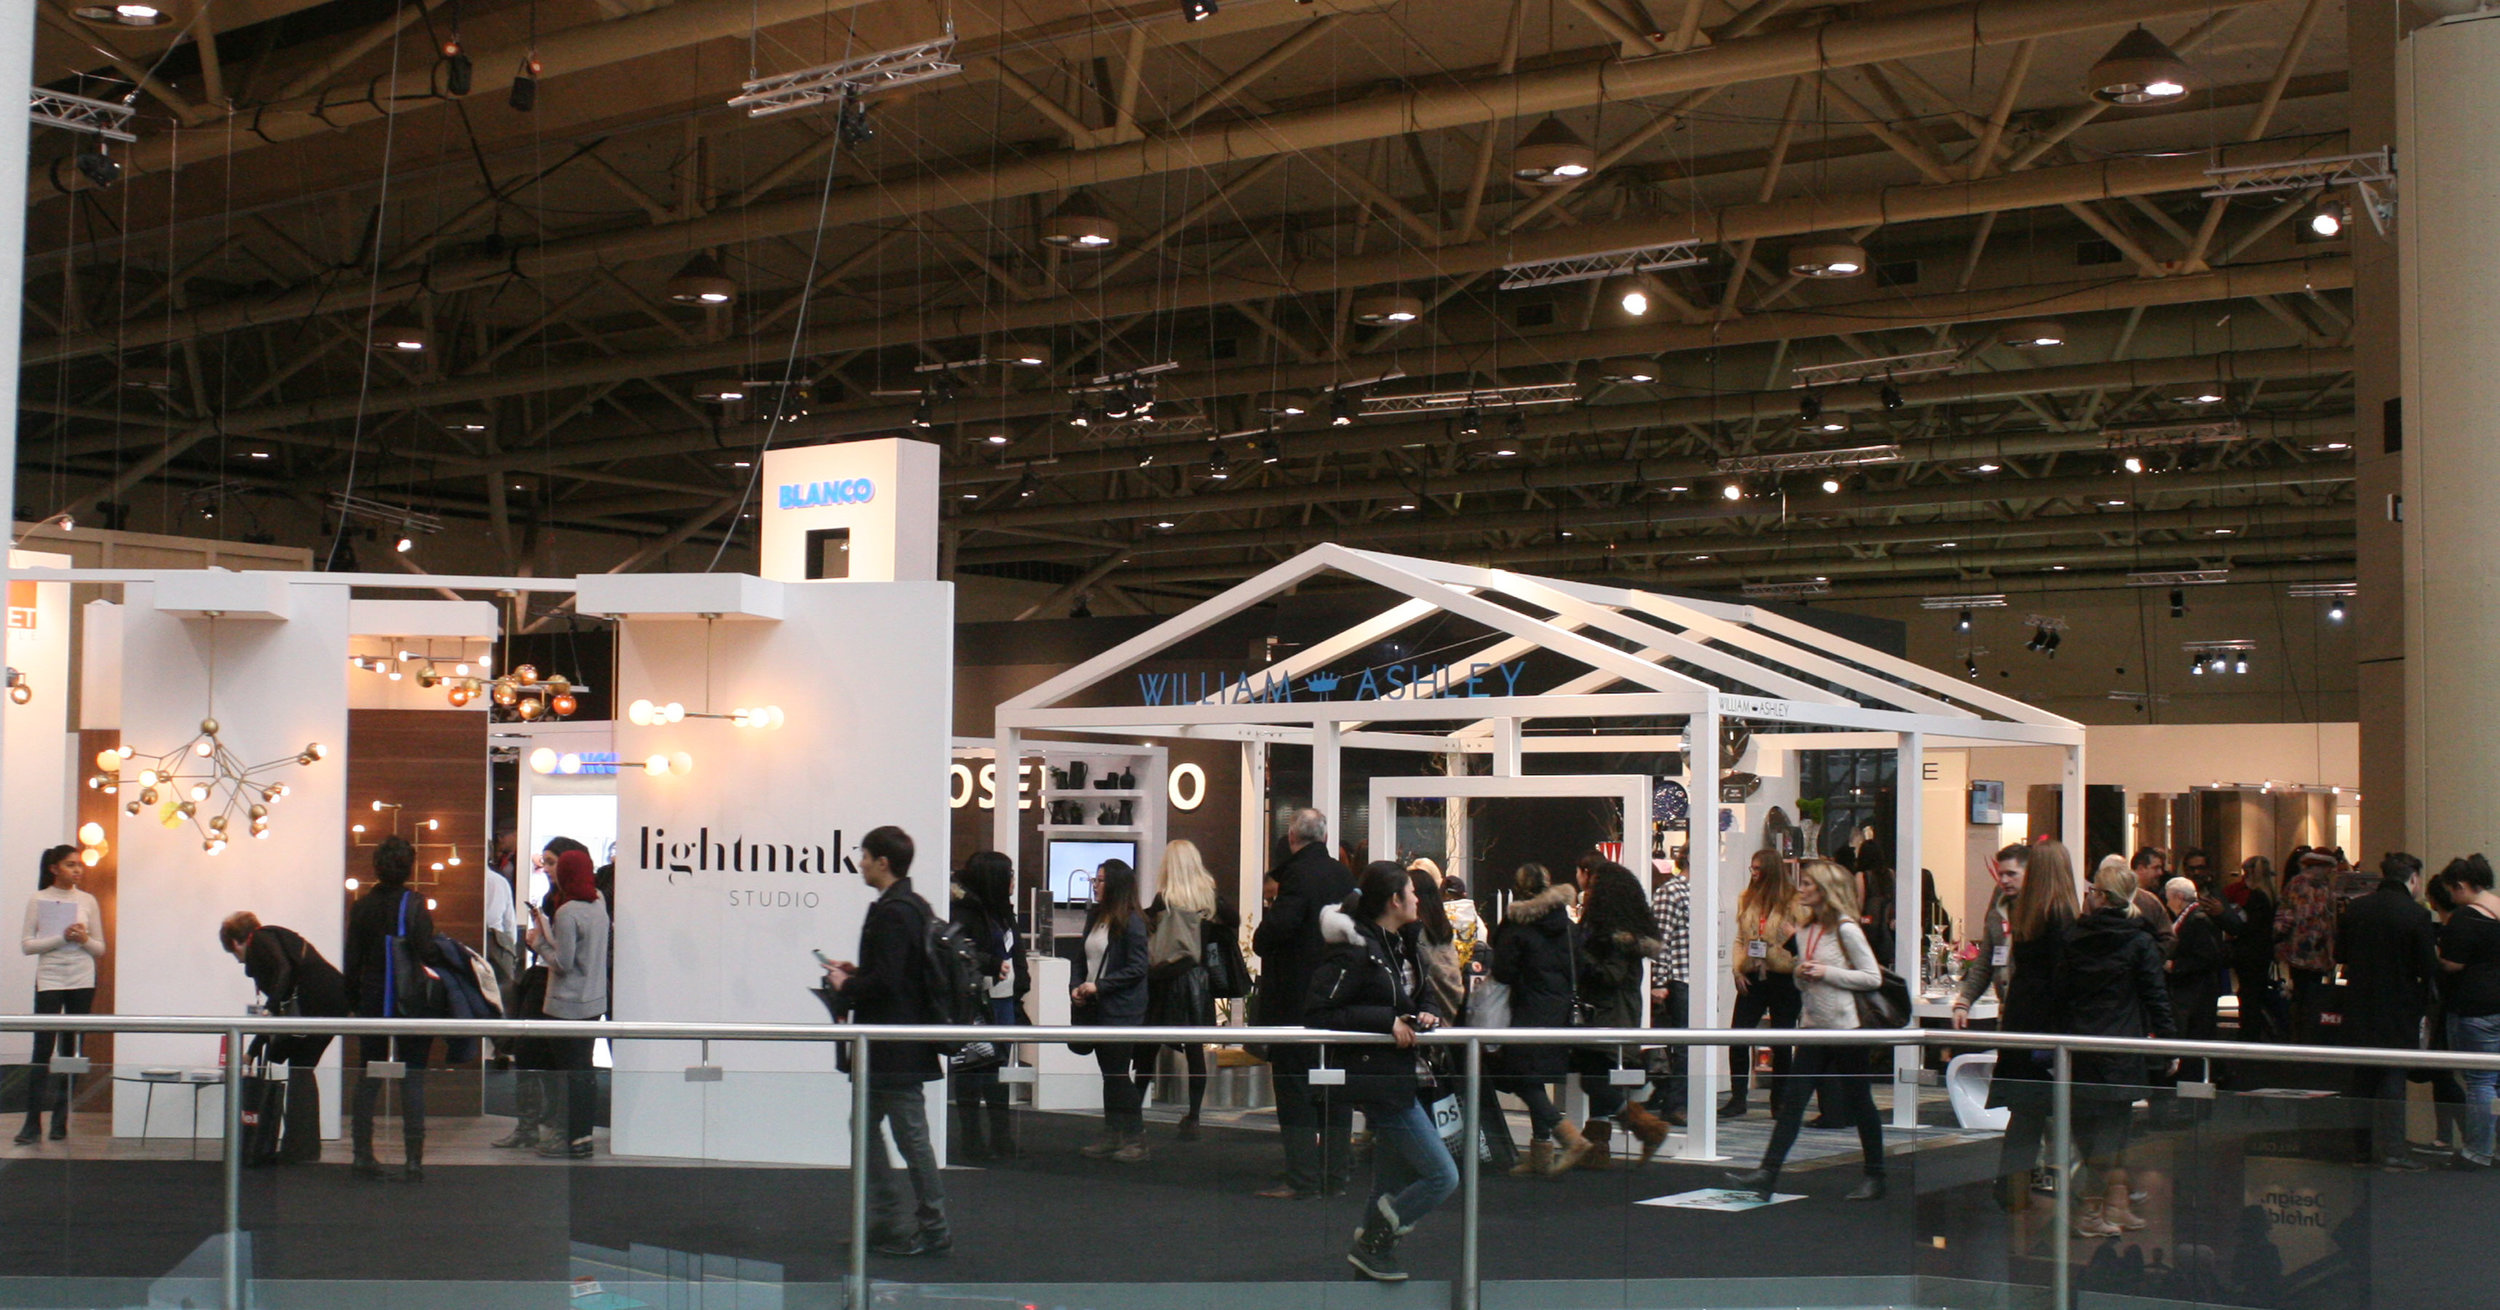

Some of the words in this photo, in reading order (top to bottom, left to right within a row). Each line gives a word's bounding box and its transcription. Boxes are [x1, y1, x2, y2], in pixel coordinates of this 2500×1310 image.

[778, 478, 875, 509] BLANCO
[1138, 670, 1292, 706] WILLIAM
[1355, 661, 1527, 701] ASHLEY
[1719, 697, 1750, 713] WILLIAM
[1759, 701, 1791, 717] ASHLEY
[640, 826, 861, 885] lightmak
[729, 889, 820, 909] STUDIO
